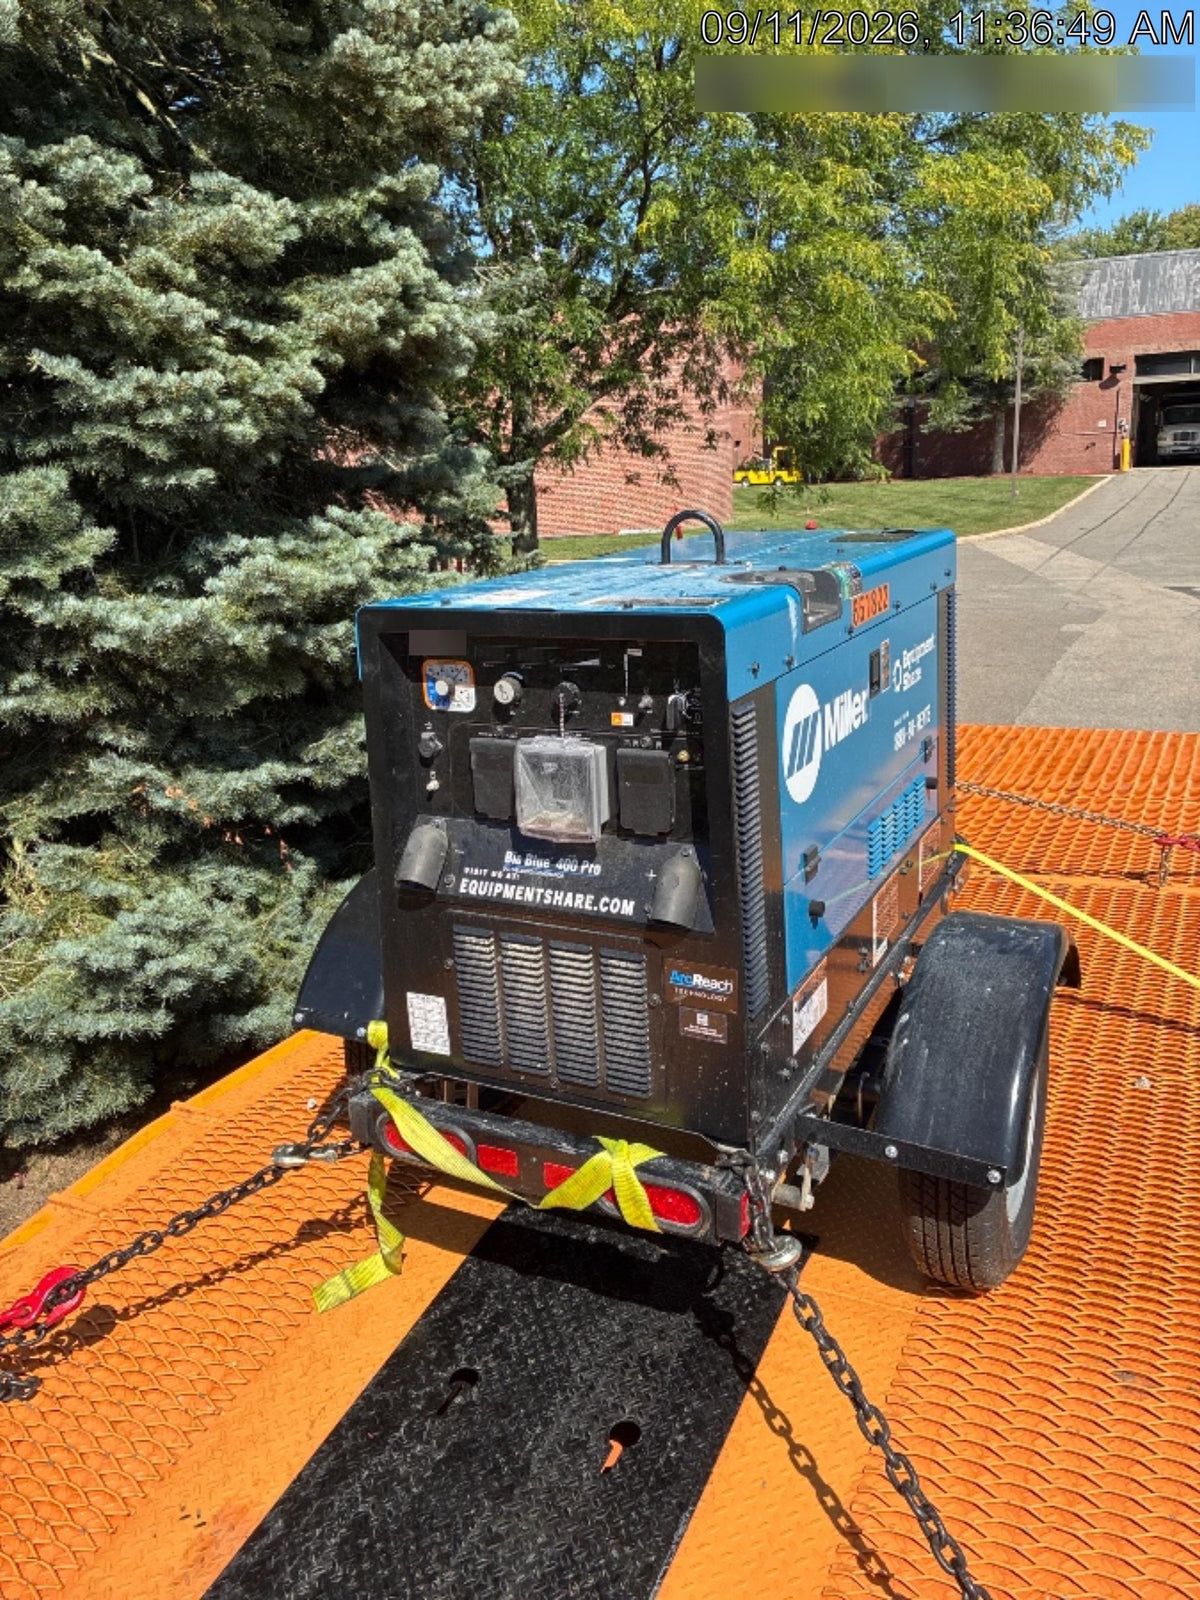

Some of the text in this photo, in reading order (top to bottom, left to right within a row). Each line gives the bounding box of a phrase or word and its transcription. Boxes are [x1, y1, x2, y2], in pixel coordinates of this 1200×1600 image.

[825, 688, 869, 752] Miller
[524, 853, 551, 868] Blue
[556, 858, 578, 872] 400
[581, 860, 602, 876] Pro
[459, 878, 635, 916] EQUIPMENTSHARE.COM
[669, 969, 734, 995] ArcReach
